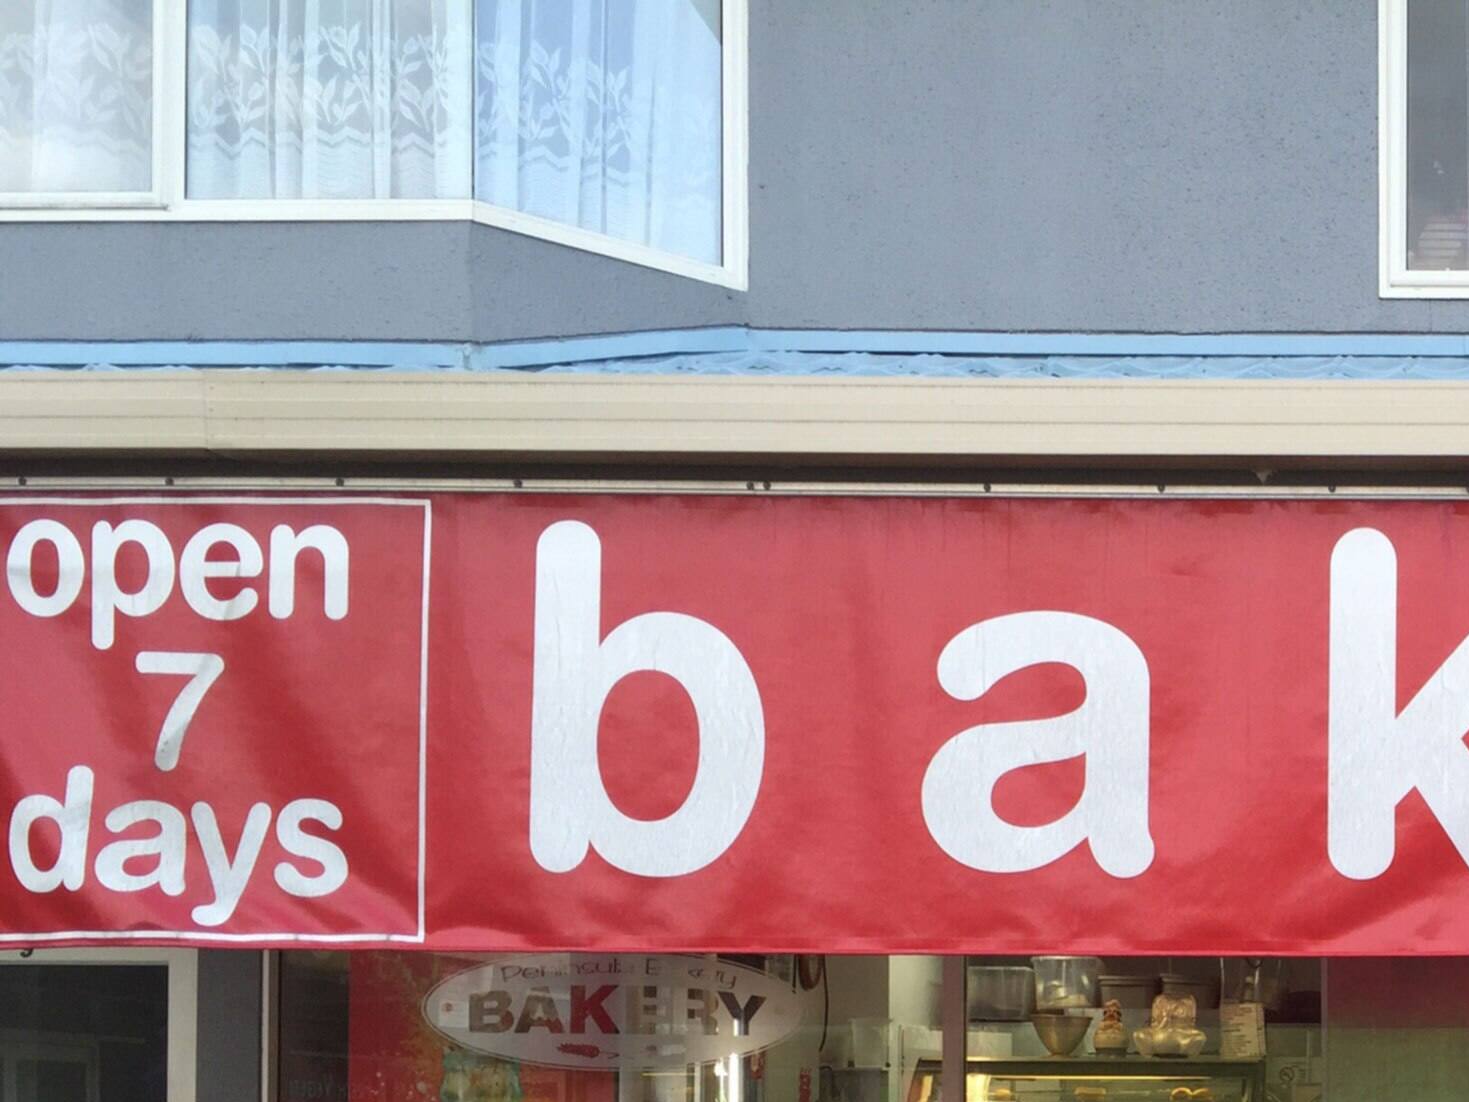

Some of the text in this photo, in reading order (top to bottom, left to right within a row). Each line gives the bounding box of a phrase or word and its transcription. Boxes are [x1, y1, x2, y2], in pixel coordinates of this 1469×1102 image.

[6, 519, 349, 650] open
[135, 651, 225, 771] 7
[8, 764, 349, 927] days
[468, 984, 767, 1036] BAKERY
